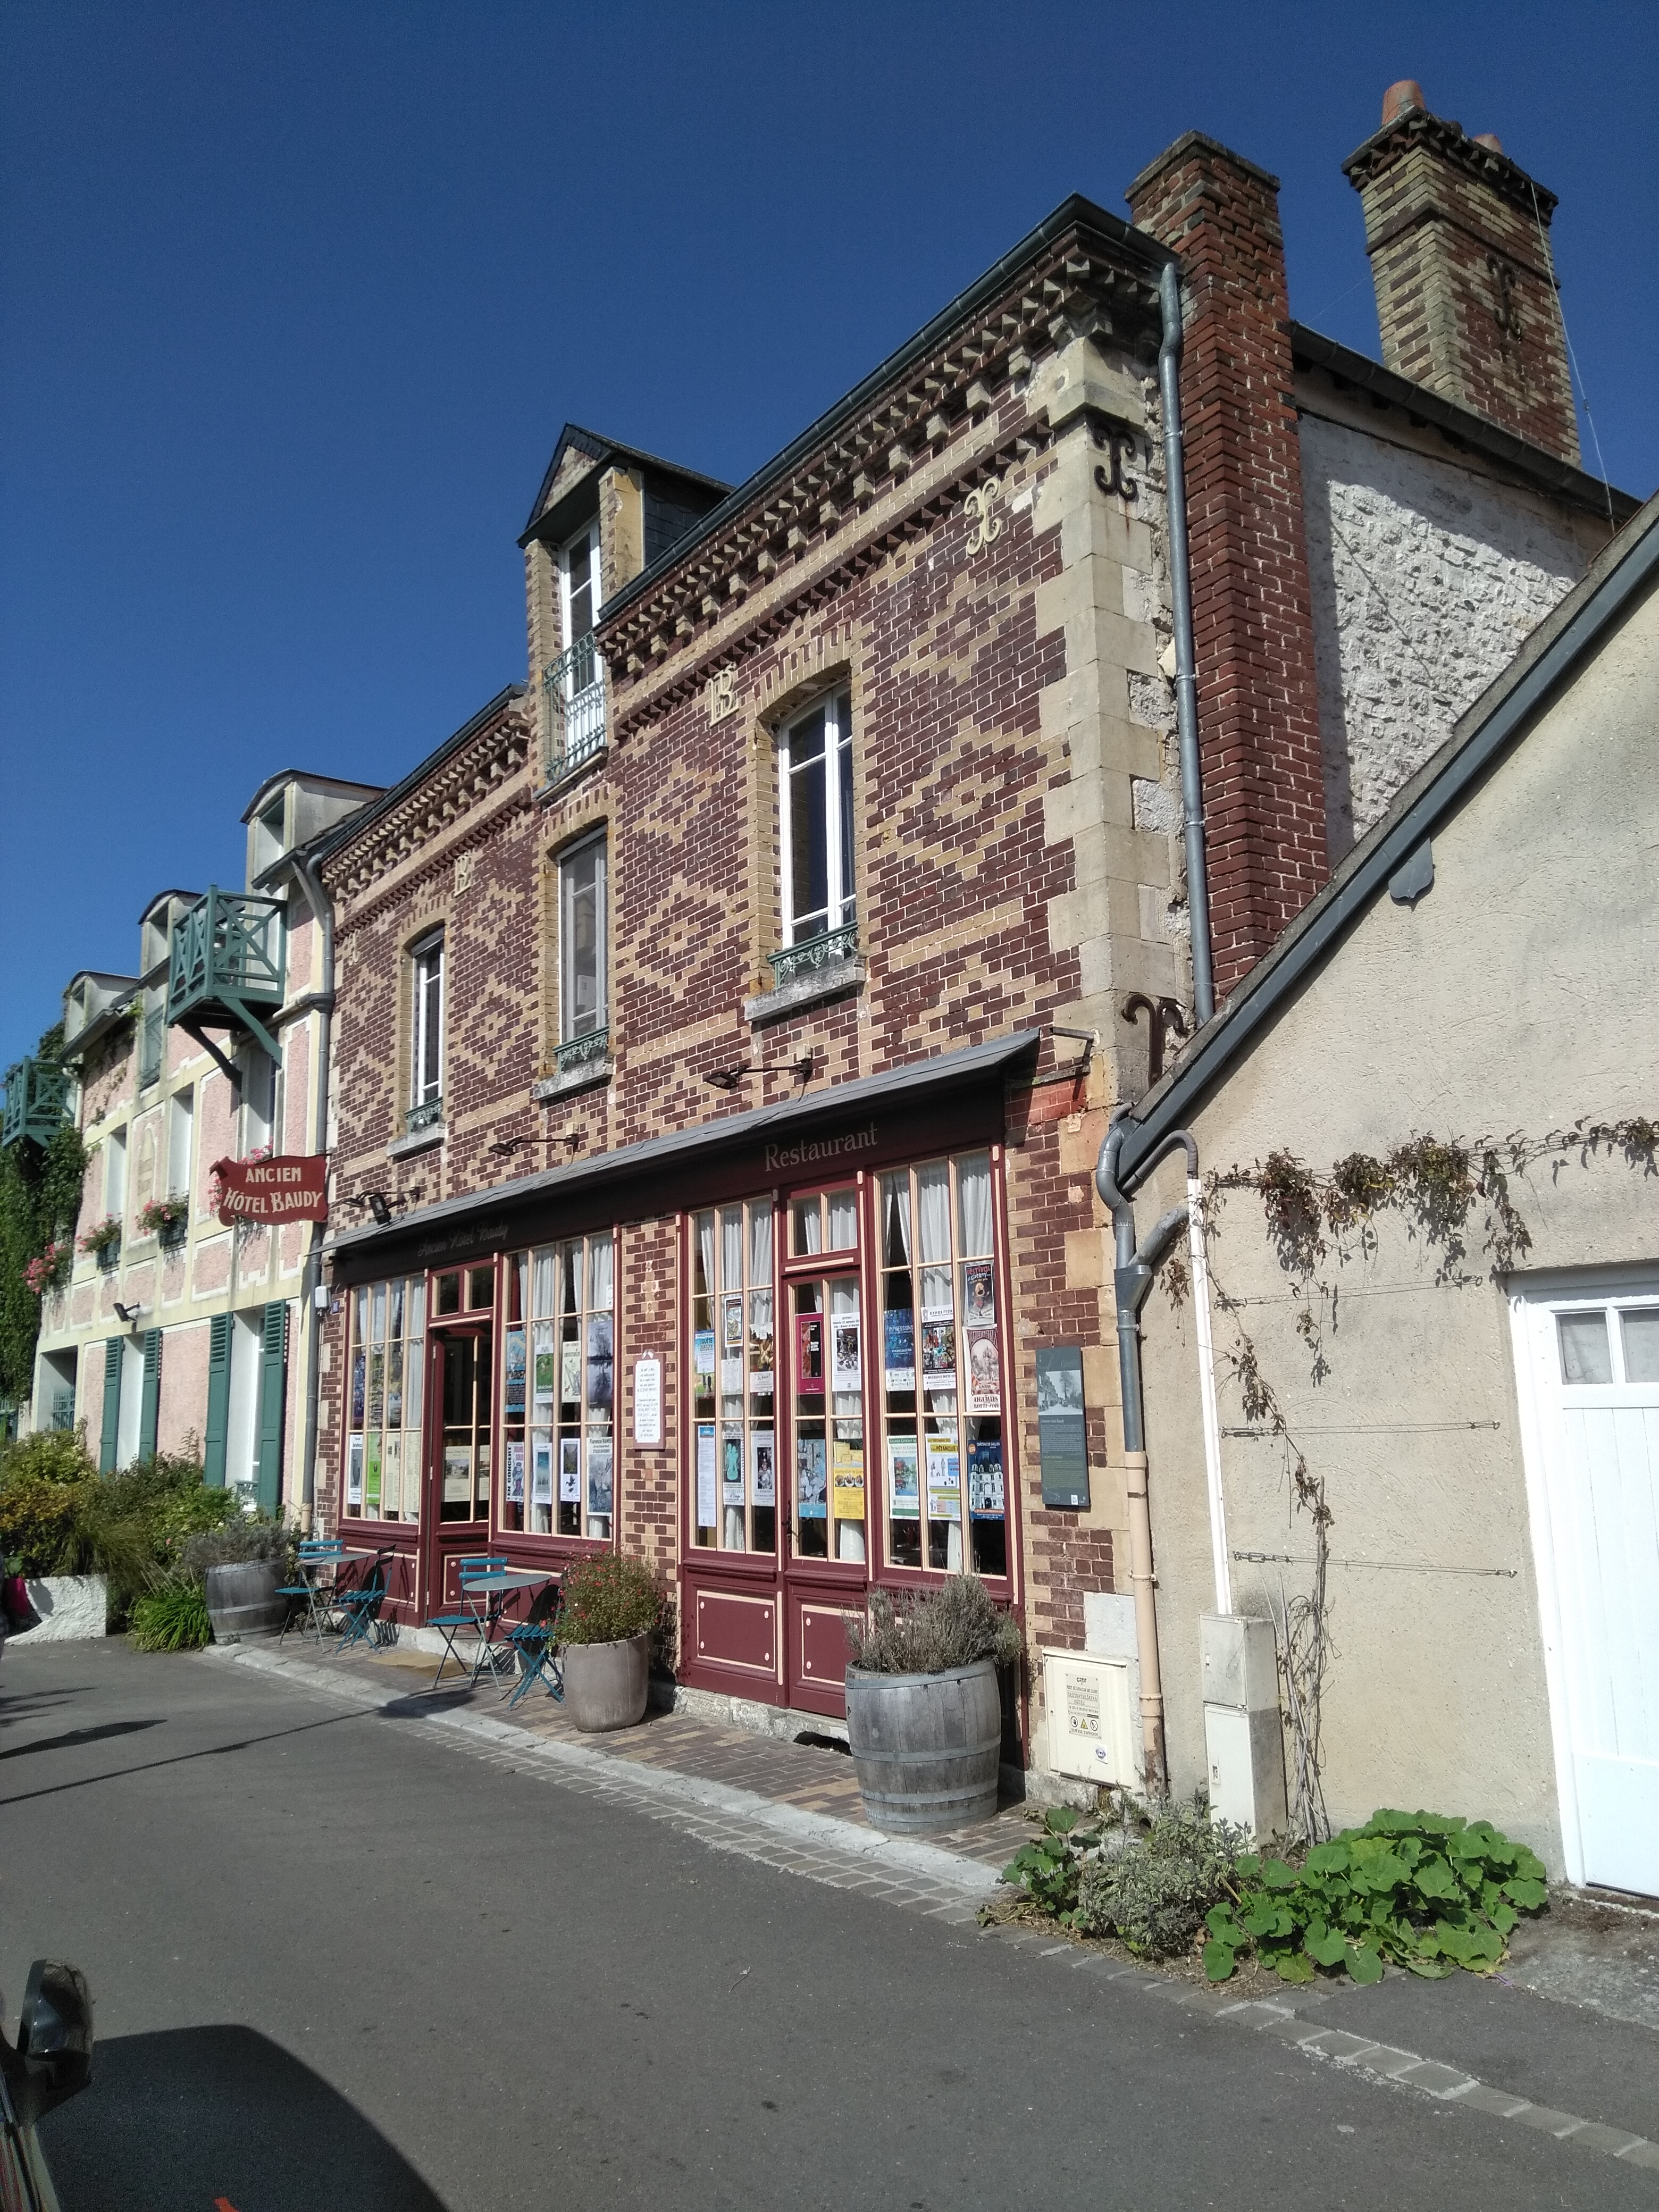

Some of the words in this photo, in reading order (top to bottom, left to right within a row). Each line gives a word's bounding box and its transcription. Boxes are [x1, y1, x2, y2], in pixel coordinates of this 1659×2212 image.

[765, 1121, 878, 1171] Restaurant
[245, 1167, 301, 1183] ANCIEN
[222, 1187, 268, 1213] HÔTEL
[270, 1191, 323, 1213] BAUDY
